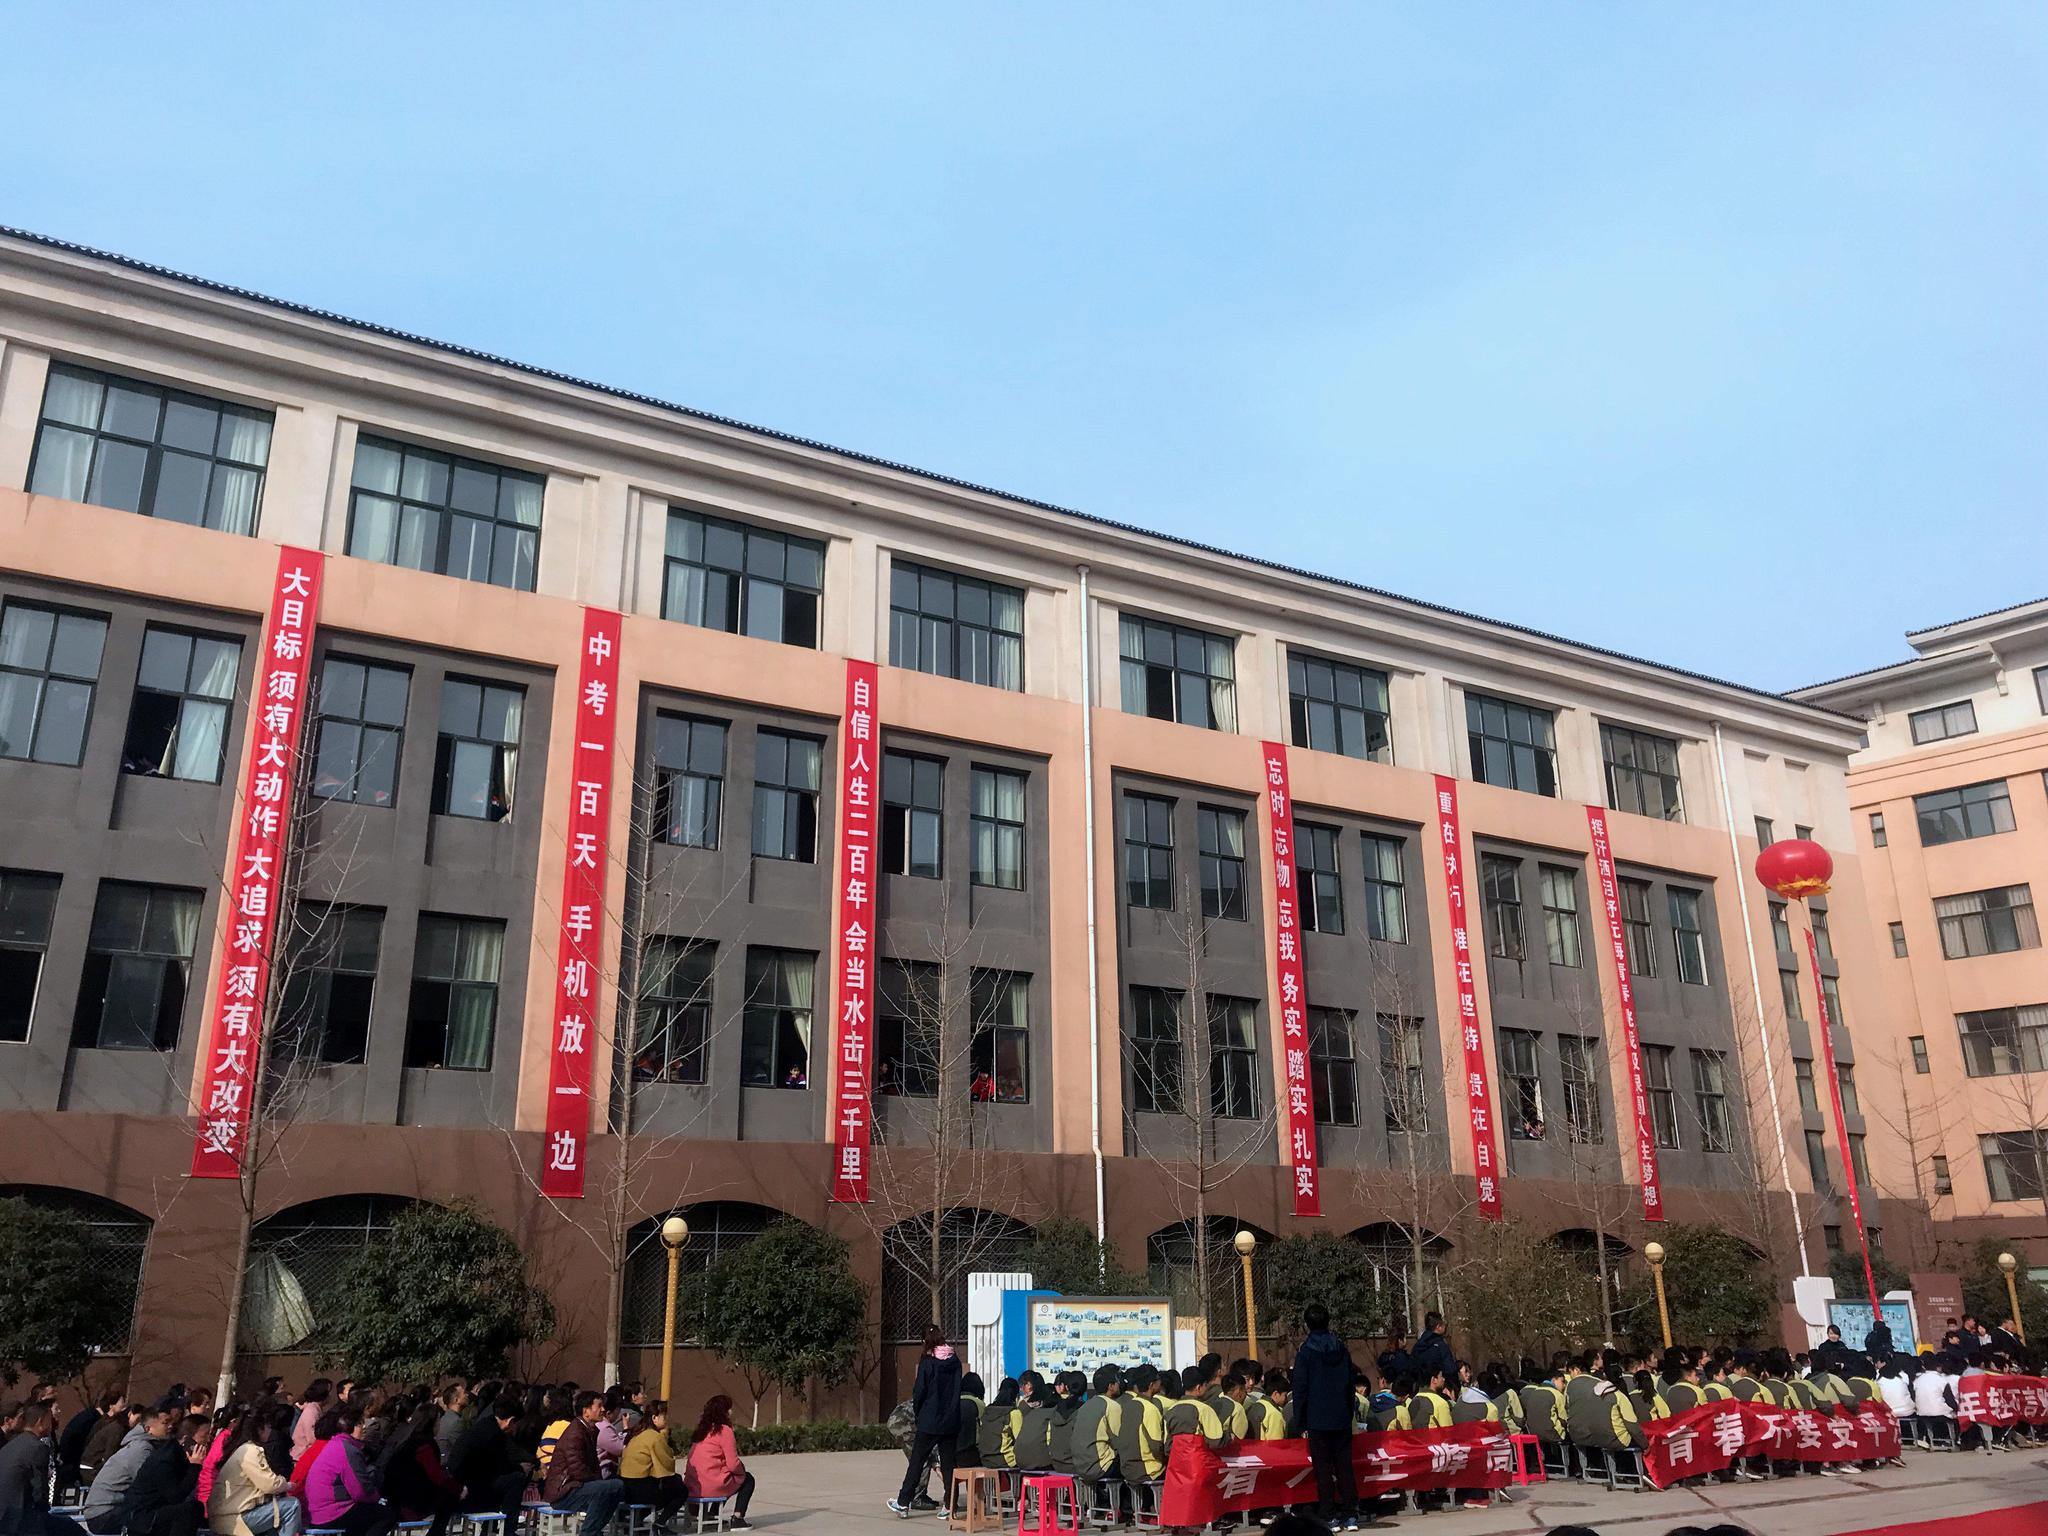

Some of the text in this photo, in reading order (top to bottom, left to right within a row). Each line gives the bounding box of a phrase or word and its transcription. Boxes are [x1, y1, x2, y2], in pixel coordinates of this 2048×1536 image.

[551, 632, 612, 1171] 中考一百天手机放一边
[840, 678, 871, 1180] 自信人生二百年会当水击三千里
[1267, 758, 1313, 1197] 忘时忘物忘我务实踏实扎实
